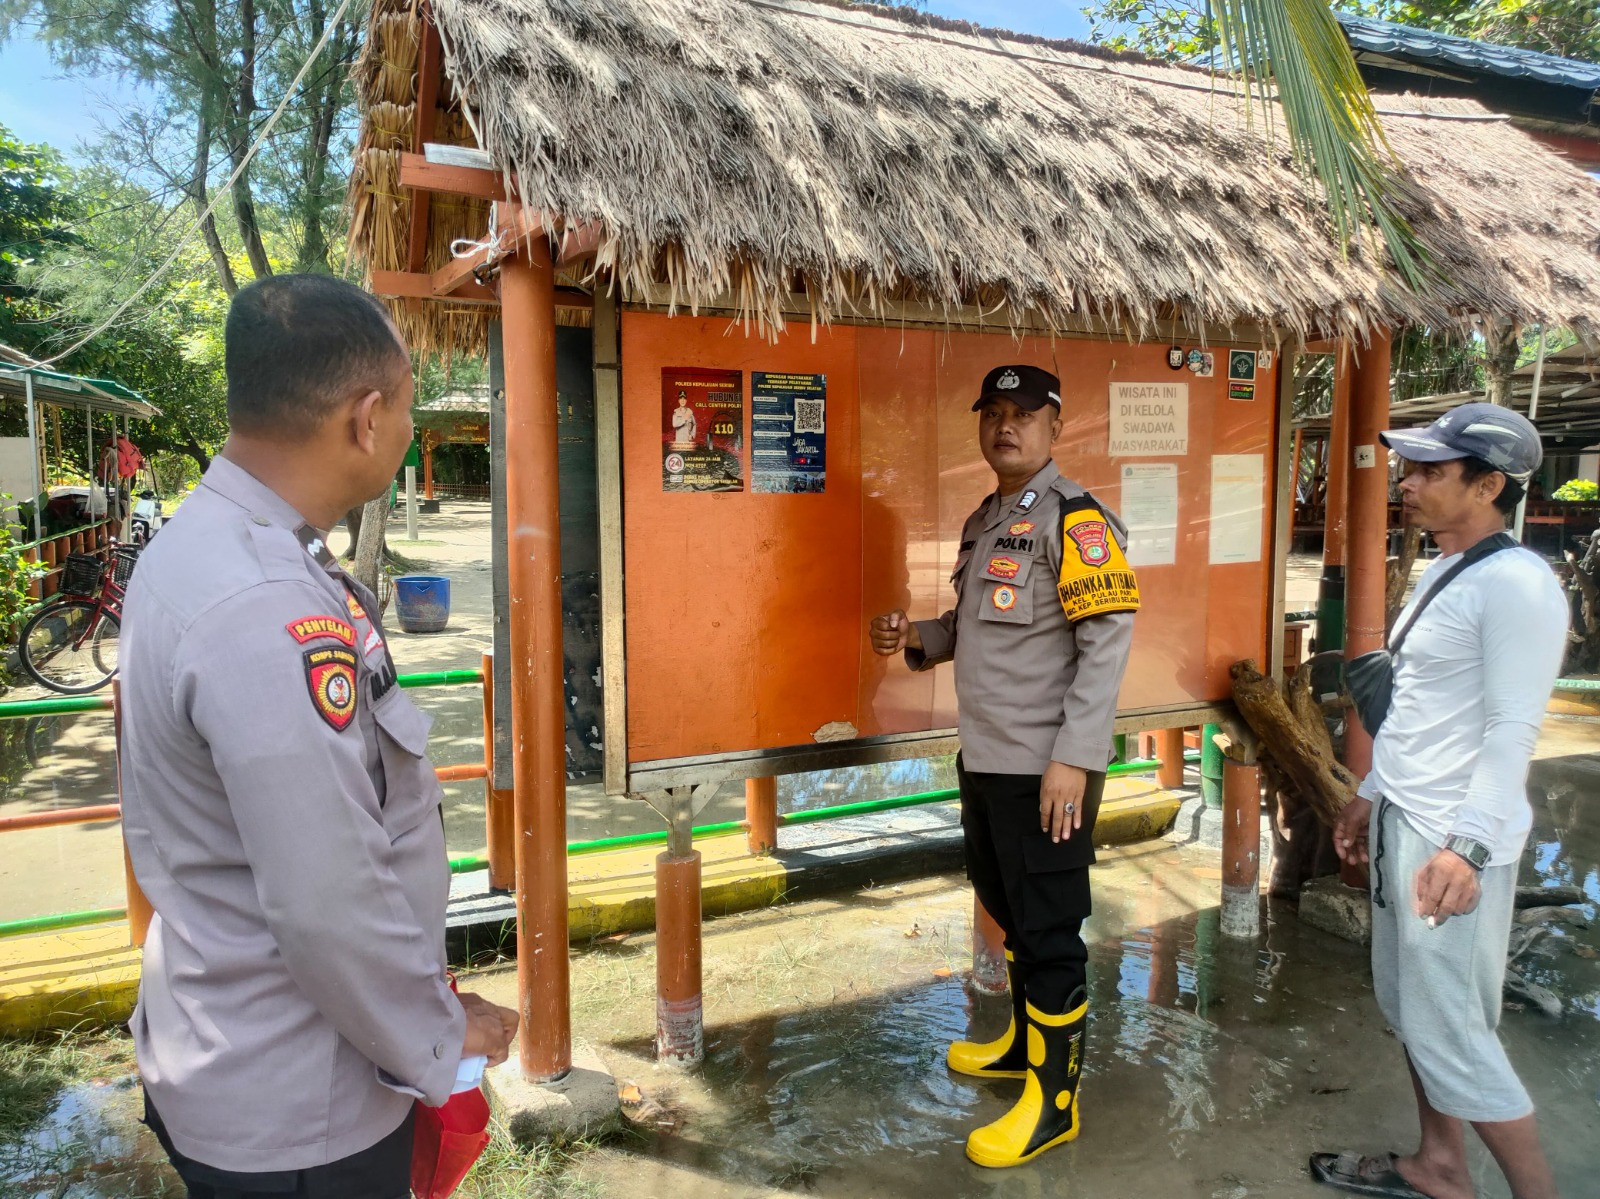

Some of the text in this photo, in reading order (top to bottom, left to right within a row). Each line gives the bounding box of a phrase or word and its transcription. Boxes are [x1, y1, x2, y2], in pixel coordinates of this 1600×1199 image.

[1118, 386, 1177, 398] WISATA INI
[1120, 404, 1175, 416] DI KELOLA
[714, 423, 734, 434] 110
[1123, 422, 1176, 434] SWADAYA
[1111, 440, 1186, 452] MASYARAKAT
[994, 537, 1034, 553] POLRI
[1091, 591, 1118, 600] PULAU
[1095, 597, 1120, 606] SERIBU
[295, 619, 351, 641] PENYELAM
